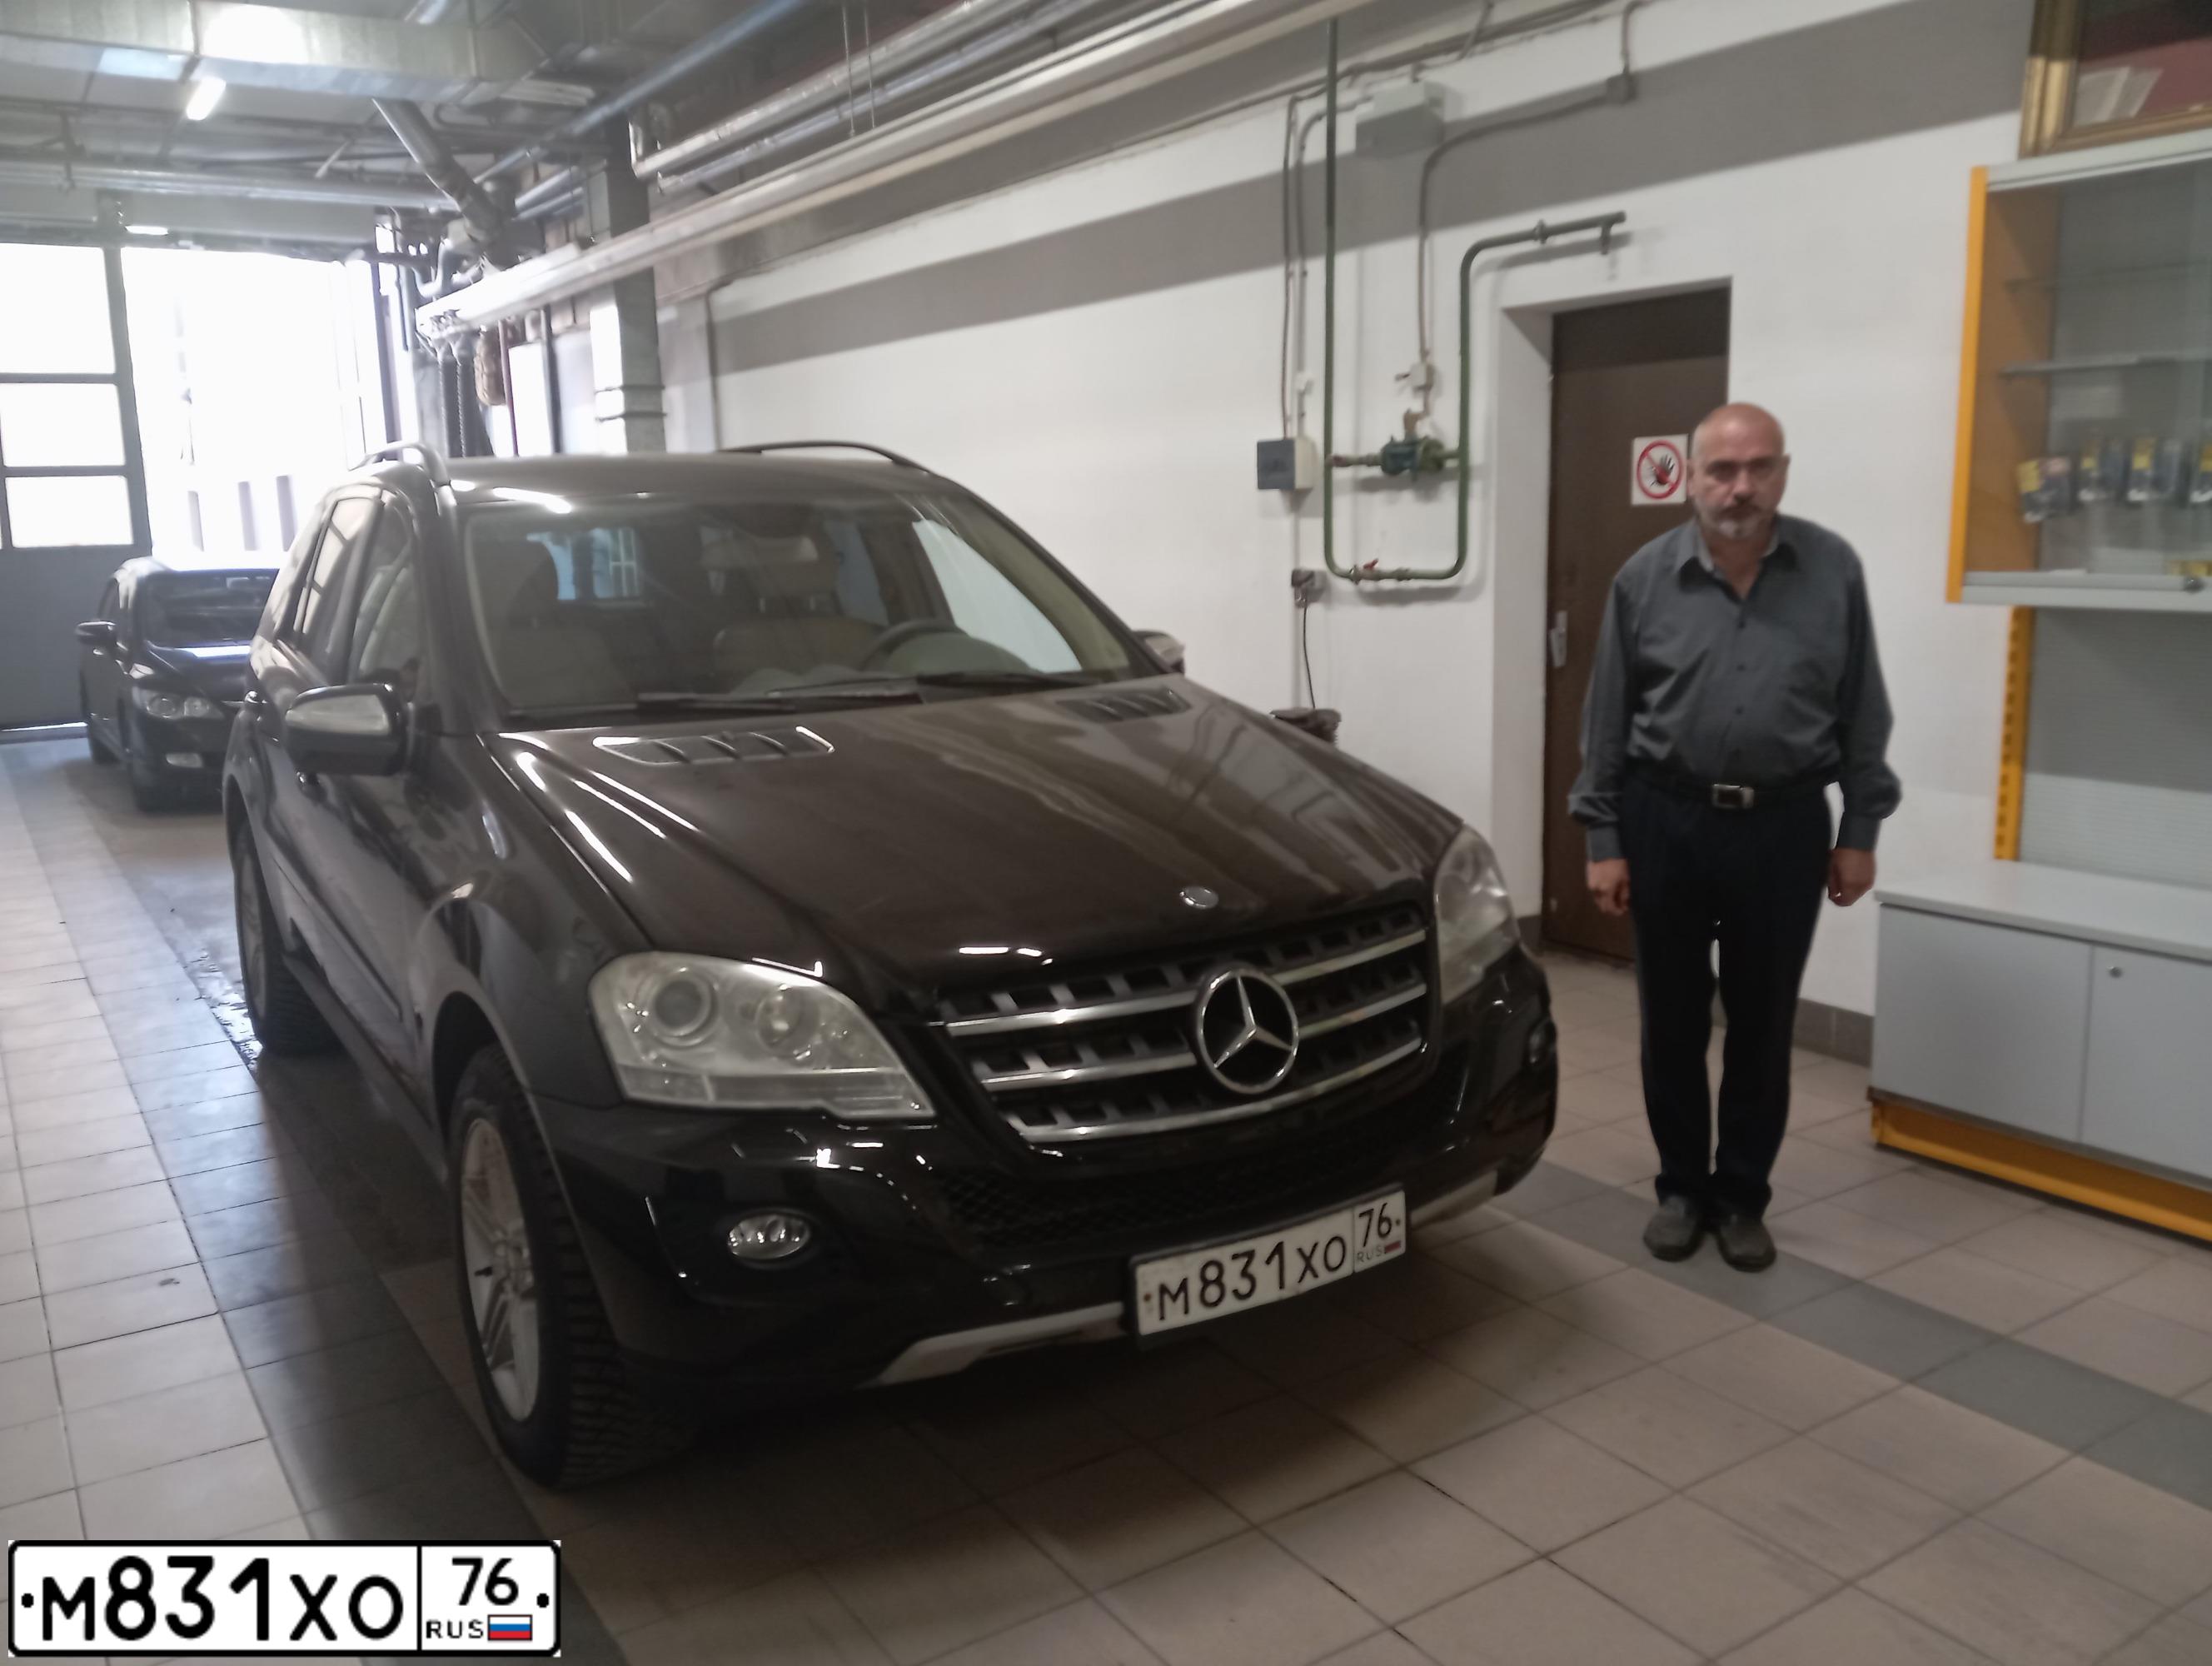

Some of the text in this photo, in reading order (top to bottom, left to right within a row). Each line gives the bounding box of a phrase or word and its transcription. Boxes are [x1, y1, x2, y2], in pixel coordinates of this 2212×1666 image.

[1158, 1203, 1392, 1321] М831ХО 76
[1357, 1245, 1384, 1264] RUS
